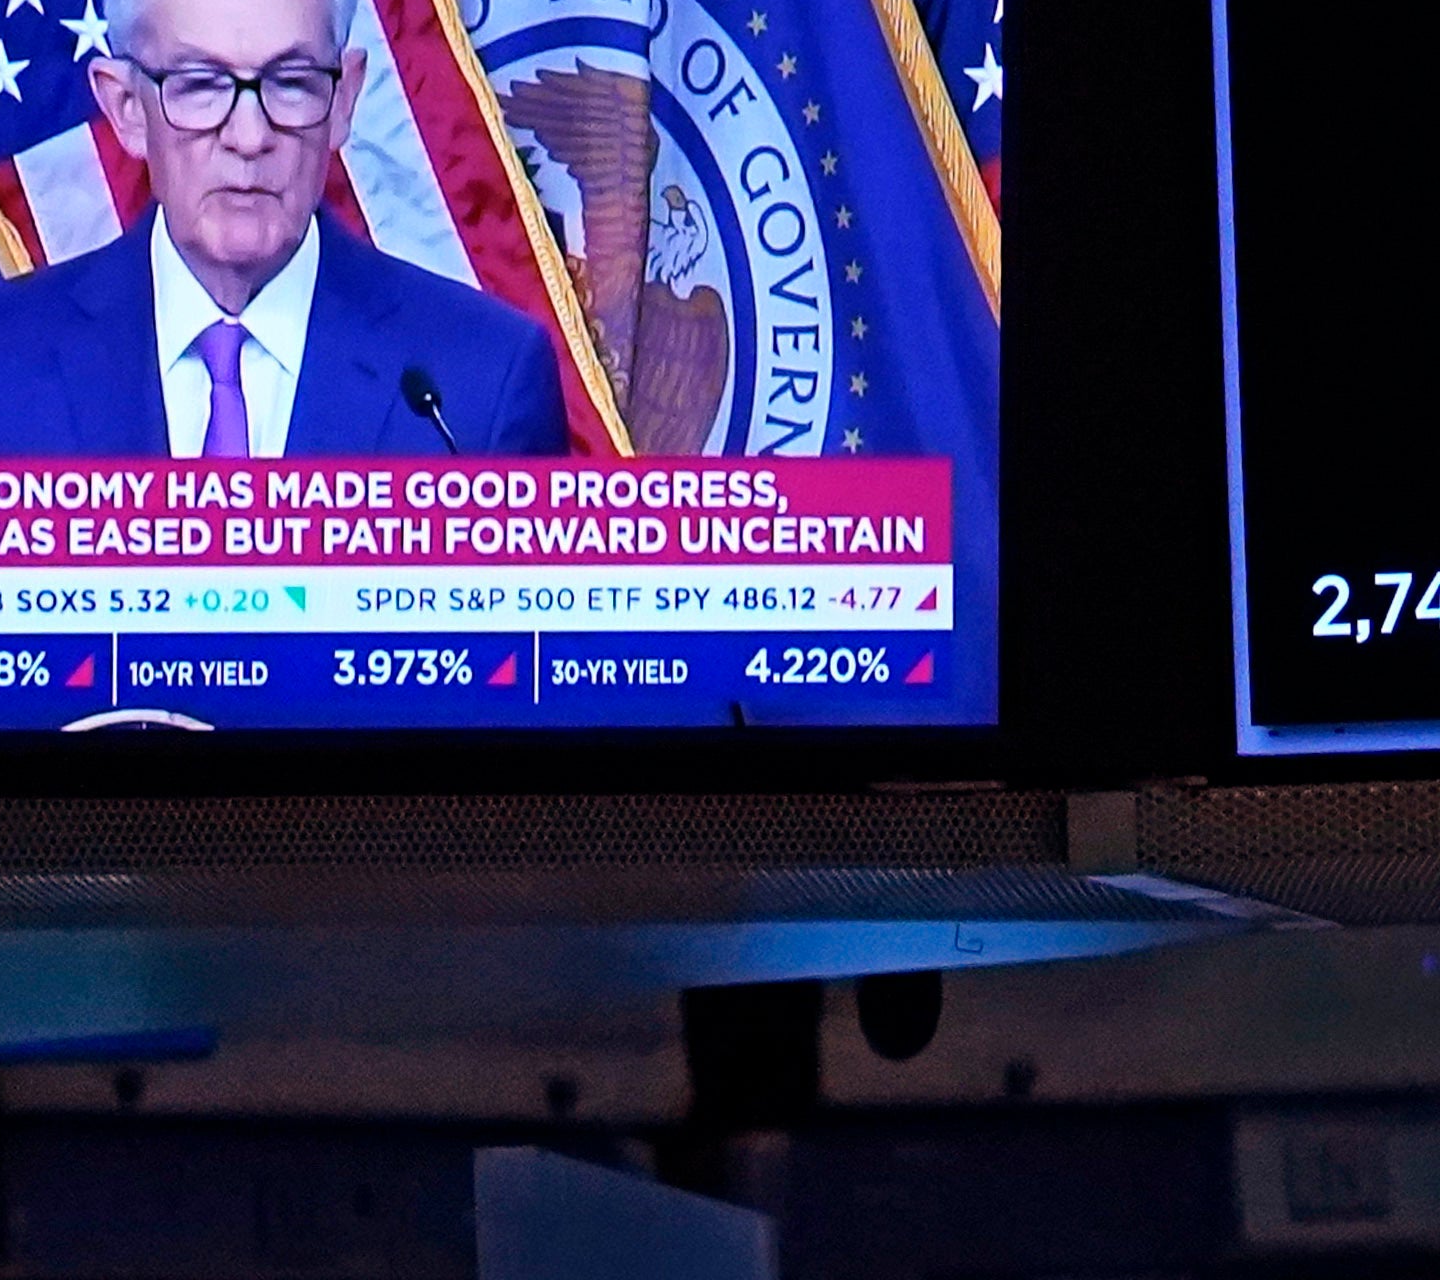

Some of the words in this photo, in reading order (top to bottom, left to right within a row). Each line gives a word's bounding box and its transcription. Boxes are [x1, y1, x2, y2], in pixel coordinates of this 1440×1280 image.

[356, 589, 436, 612] SPDR
[449, 589, 505, 611] S&P
[516, 588, 575, 611] 500
[588, 589, 640, 611] ETF
[656, 588, 709, 611] SPY
[723, 588, 816, 611] 486.12
[829, 588, 901, 610] -4.77
